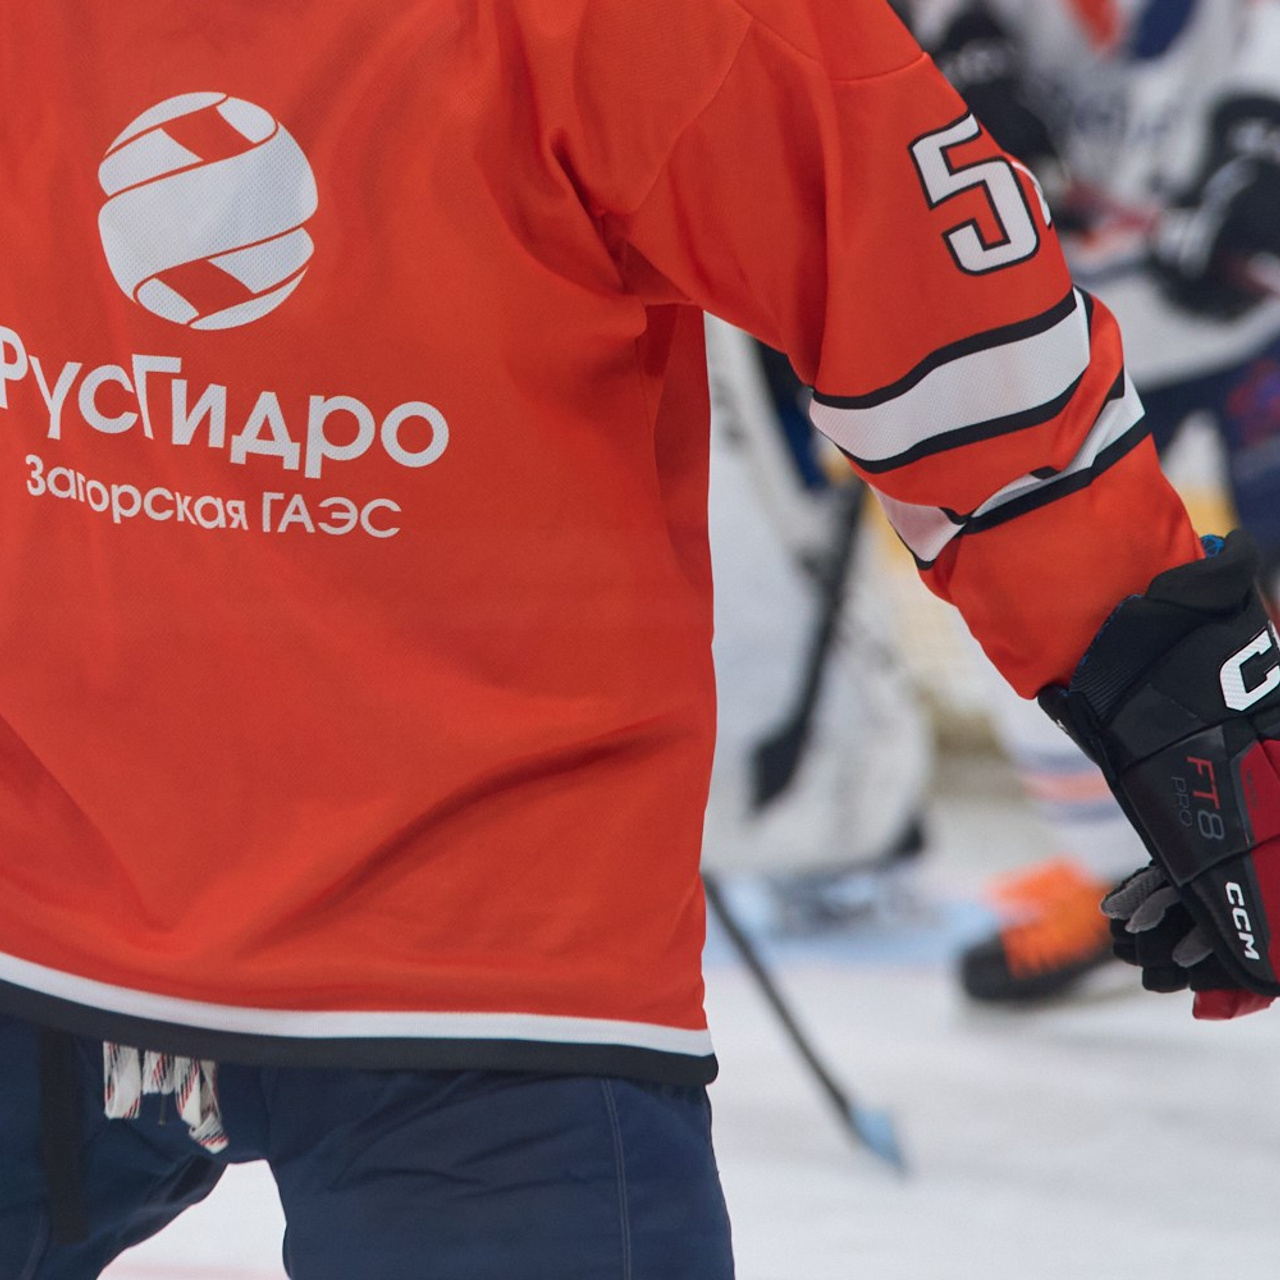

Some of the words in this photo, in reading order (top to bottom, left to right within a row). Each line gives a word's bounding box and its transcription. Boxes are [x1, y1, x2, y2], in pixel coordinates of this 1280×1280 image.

[908, 111, 1053, 277] 5
[24, 453, 250, 531] Загорская
[261, 491, 403, 539] ГАЭС
[1170, 775, 1193, 827] PRO
[1185, 755, 1225, 840] FT8
[1224, 881, 1261, 960] CCM
